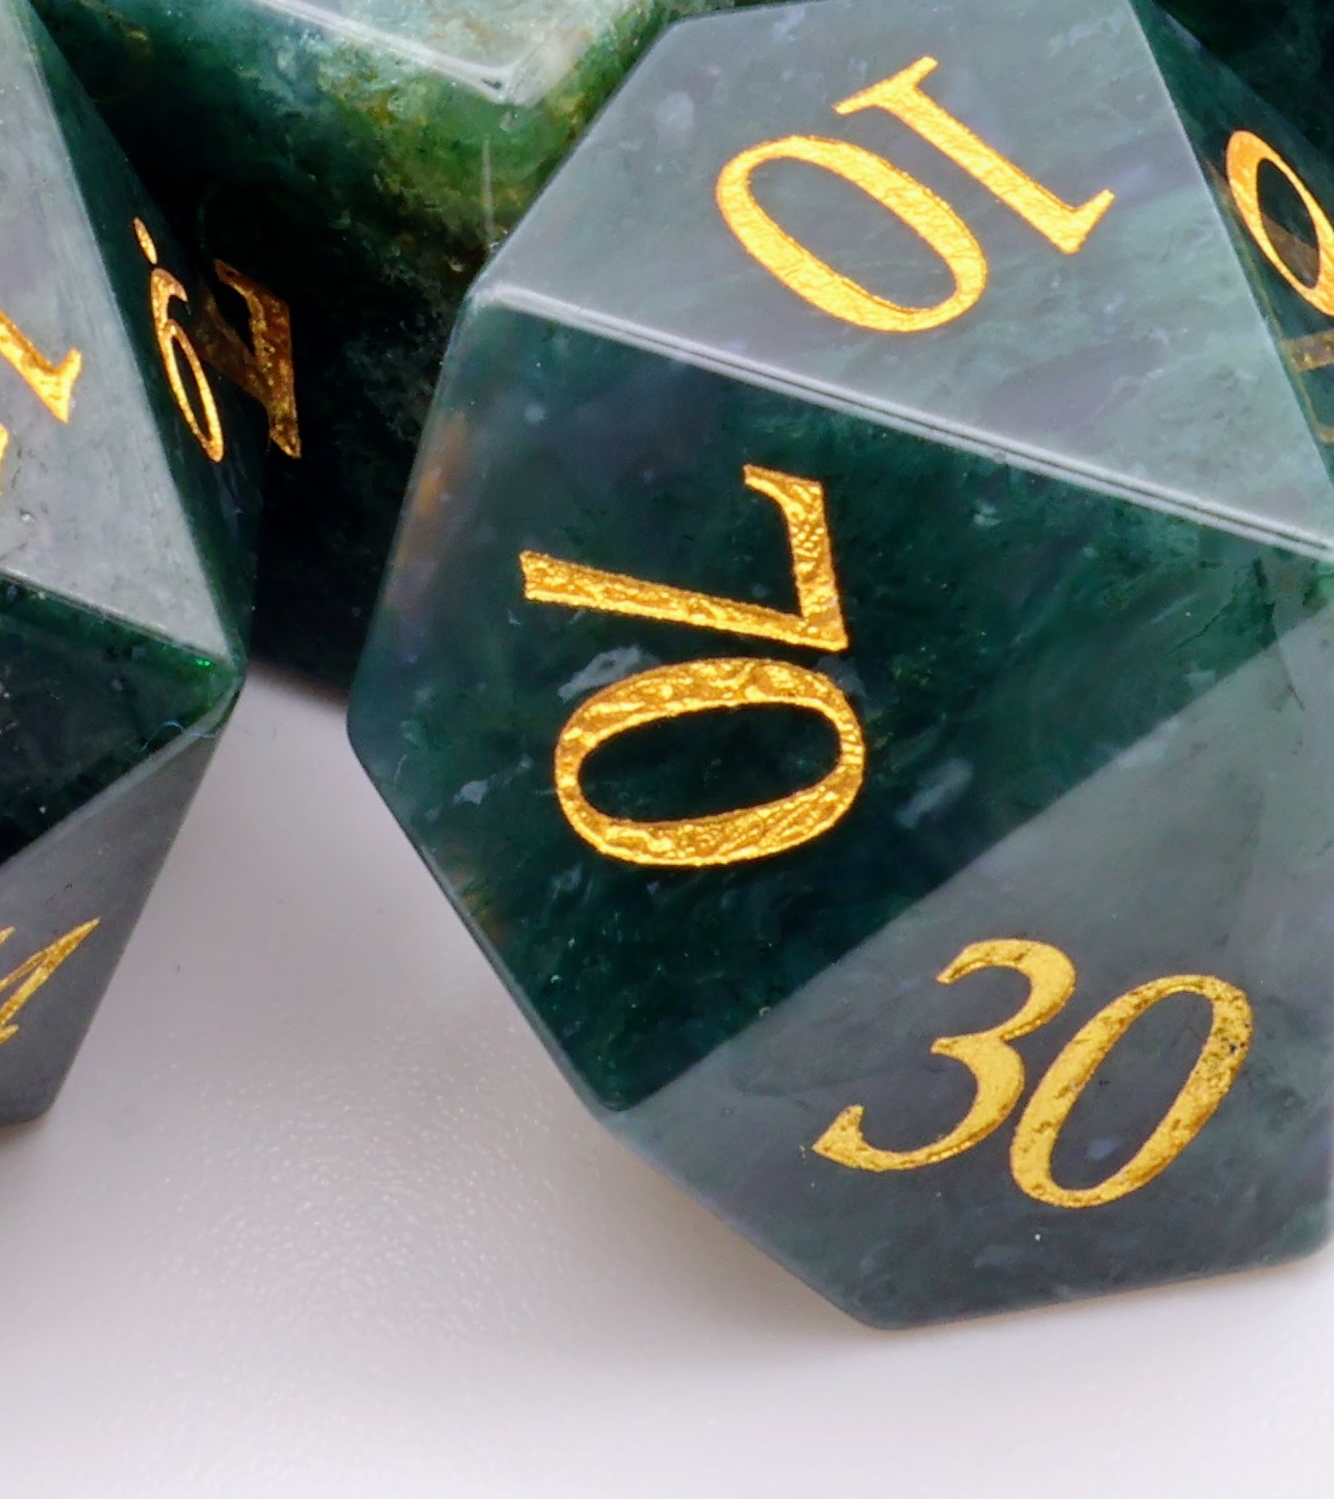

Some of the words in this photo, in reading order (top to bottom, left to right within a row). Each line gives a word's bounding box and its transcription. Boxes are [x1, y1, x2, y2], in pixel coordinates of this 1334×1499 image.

[715, 57, 1114, 336] 10
[517, 462, 869, 870] 70
[811, 936, 1255, 1212] 30
